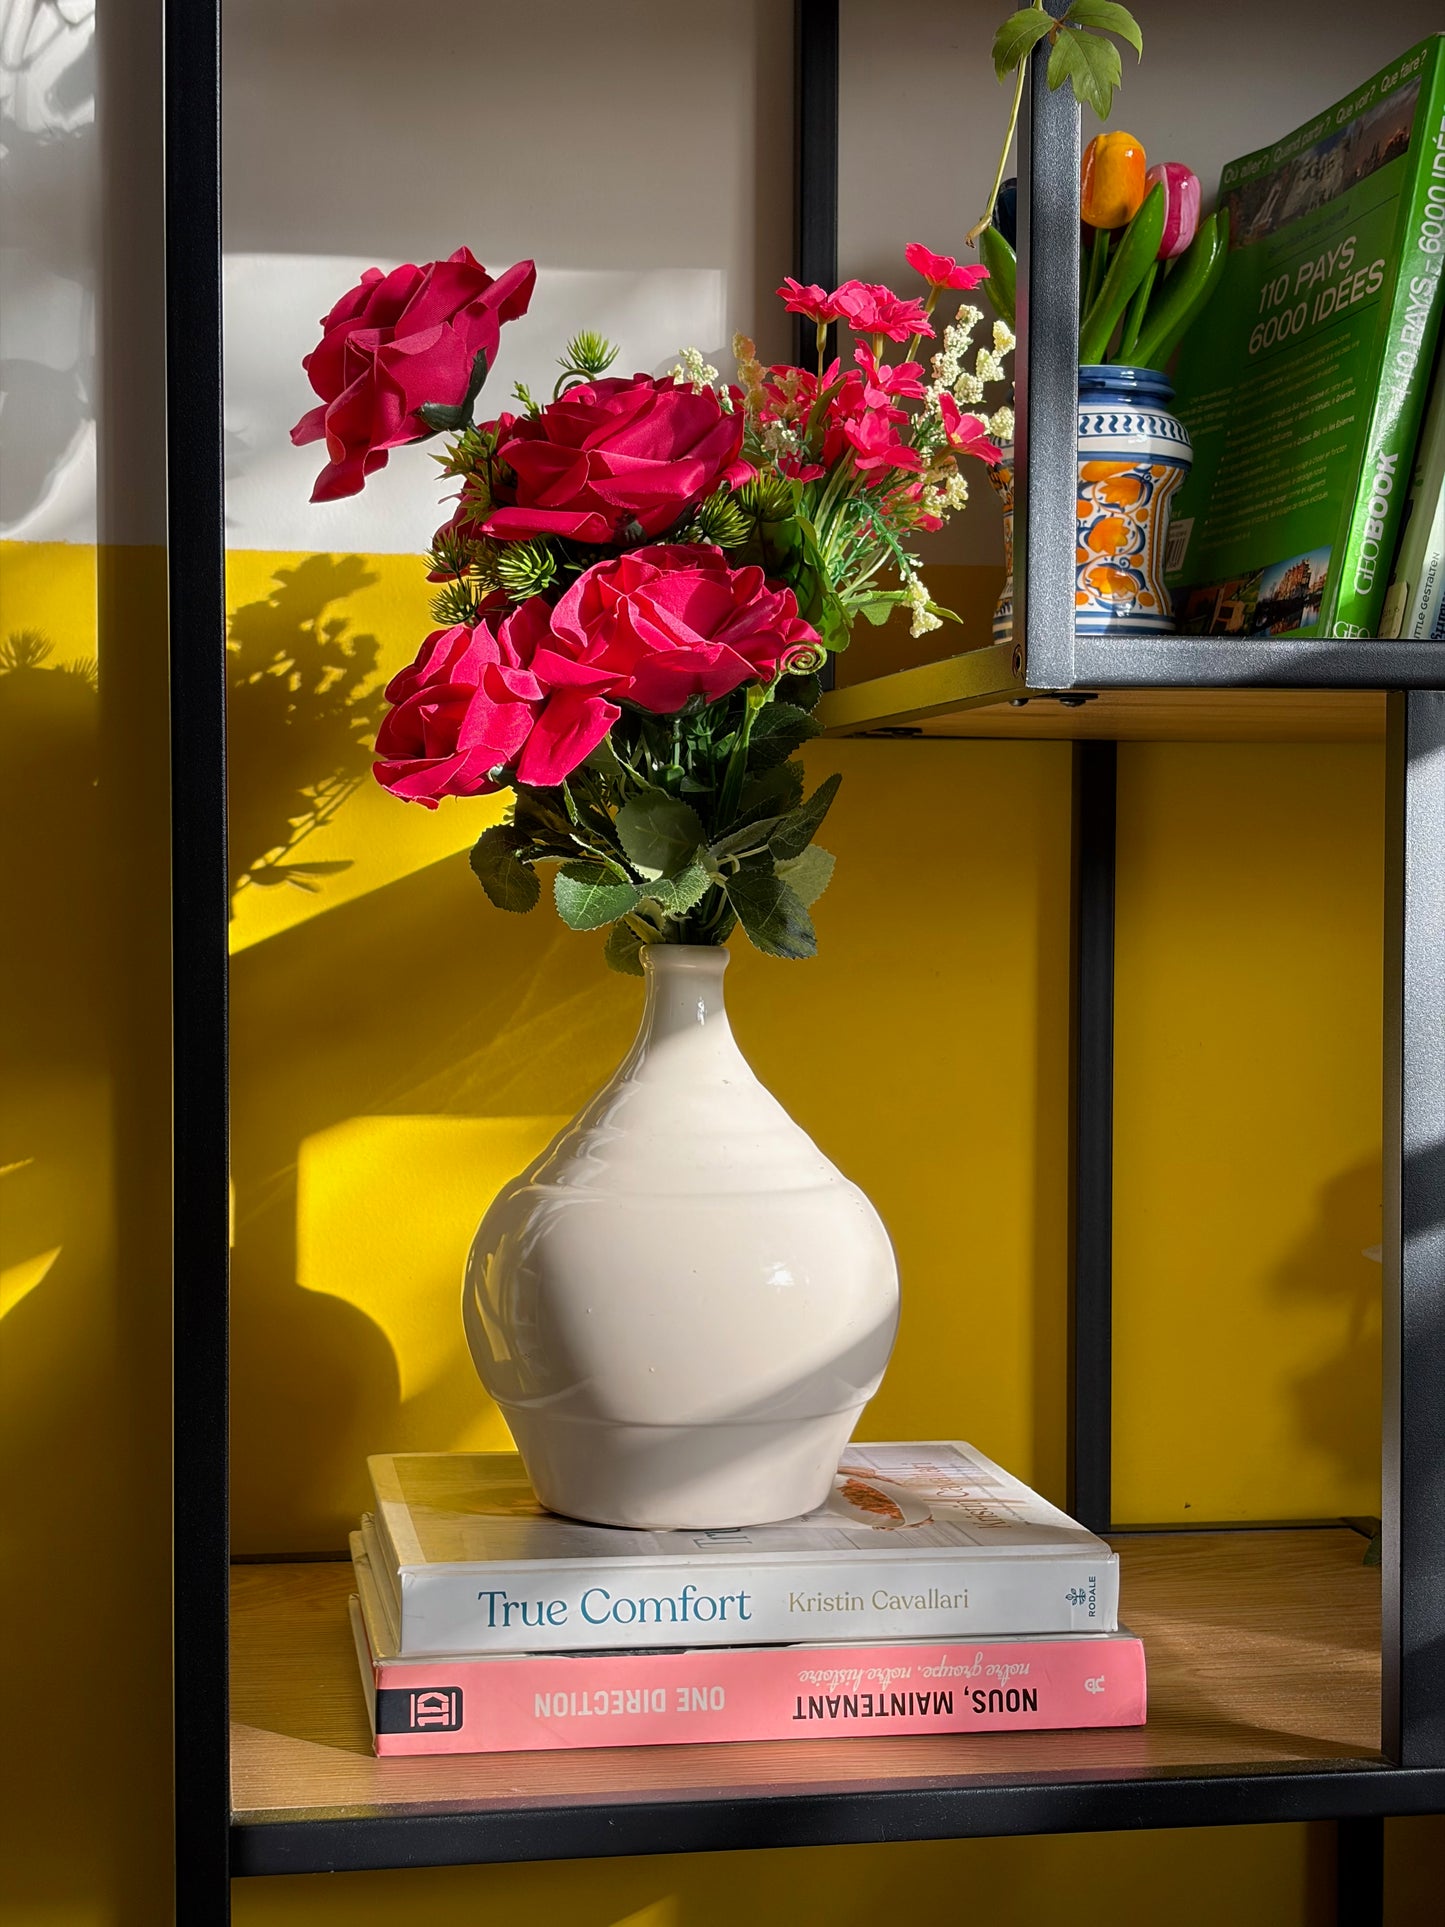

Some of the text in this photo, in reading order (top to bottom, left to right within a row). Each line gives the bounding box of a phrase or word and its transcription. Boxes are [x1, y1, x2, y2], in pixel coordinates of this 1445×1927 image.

[1381, 72, 1399, 92] Que
[1258, 236, 1357, 314] 110 PAYS
[1249, 258, 1386, 354] 6000 IDÉES
[1400, 276, 1434, 346] PAYS
[1353, 450, 1399, 596] GEOBOOK
[477, 1575, 1096, 1628] True Comfort Kristin Cavallari RODALE
[797, 1666, 868, 1693] histoire
[867, 1667, 912, 1692] notre
[985, 1663, 1031, 1688] notre
[534, 1688, 666, 1718] DIRECTION
[677, 1686, 725, 1712] ONE
[792, 1690, 954, 1720] MAINTENANT
[964, 1686, 1038, 1714] NOUS,
